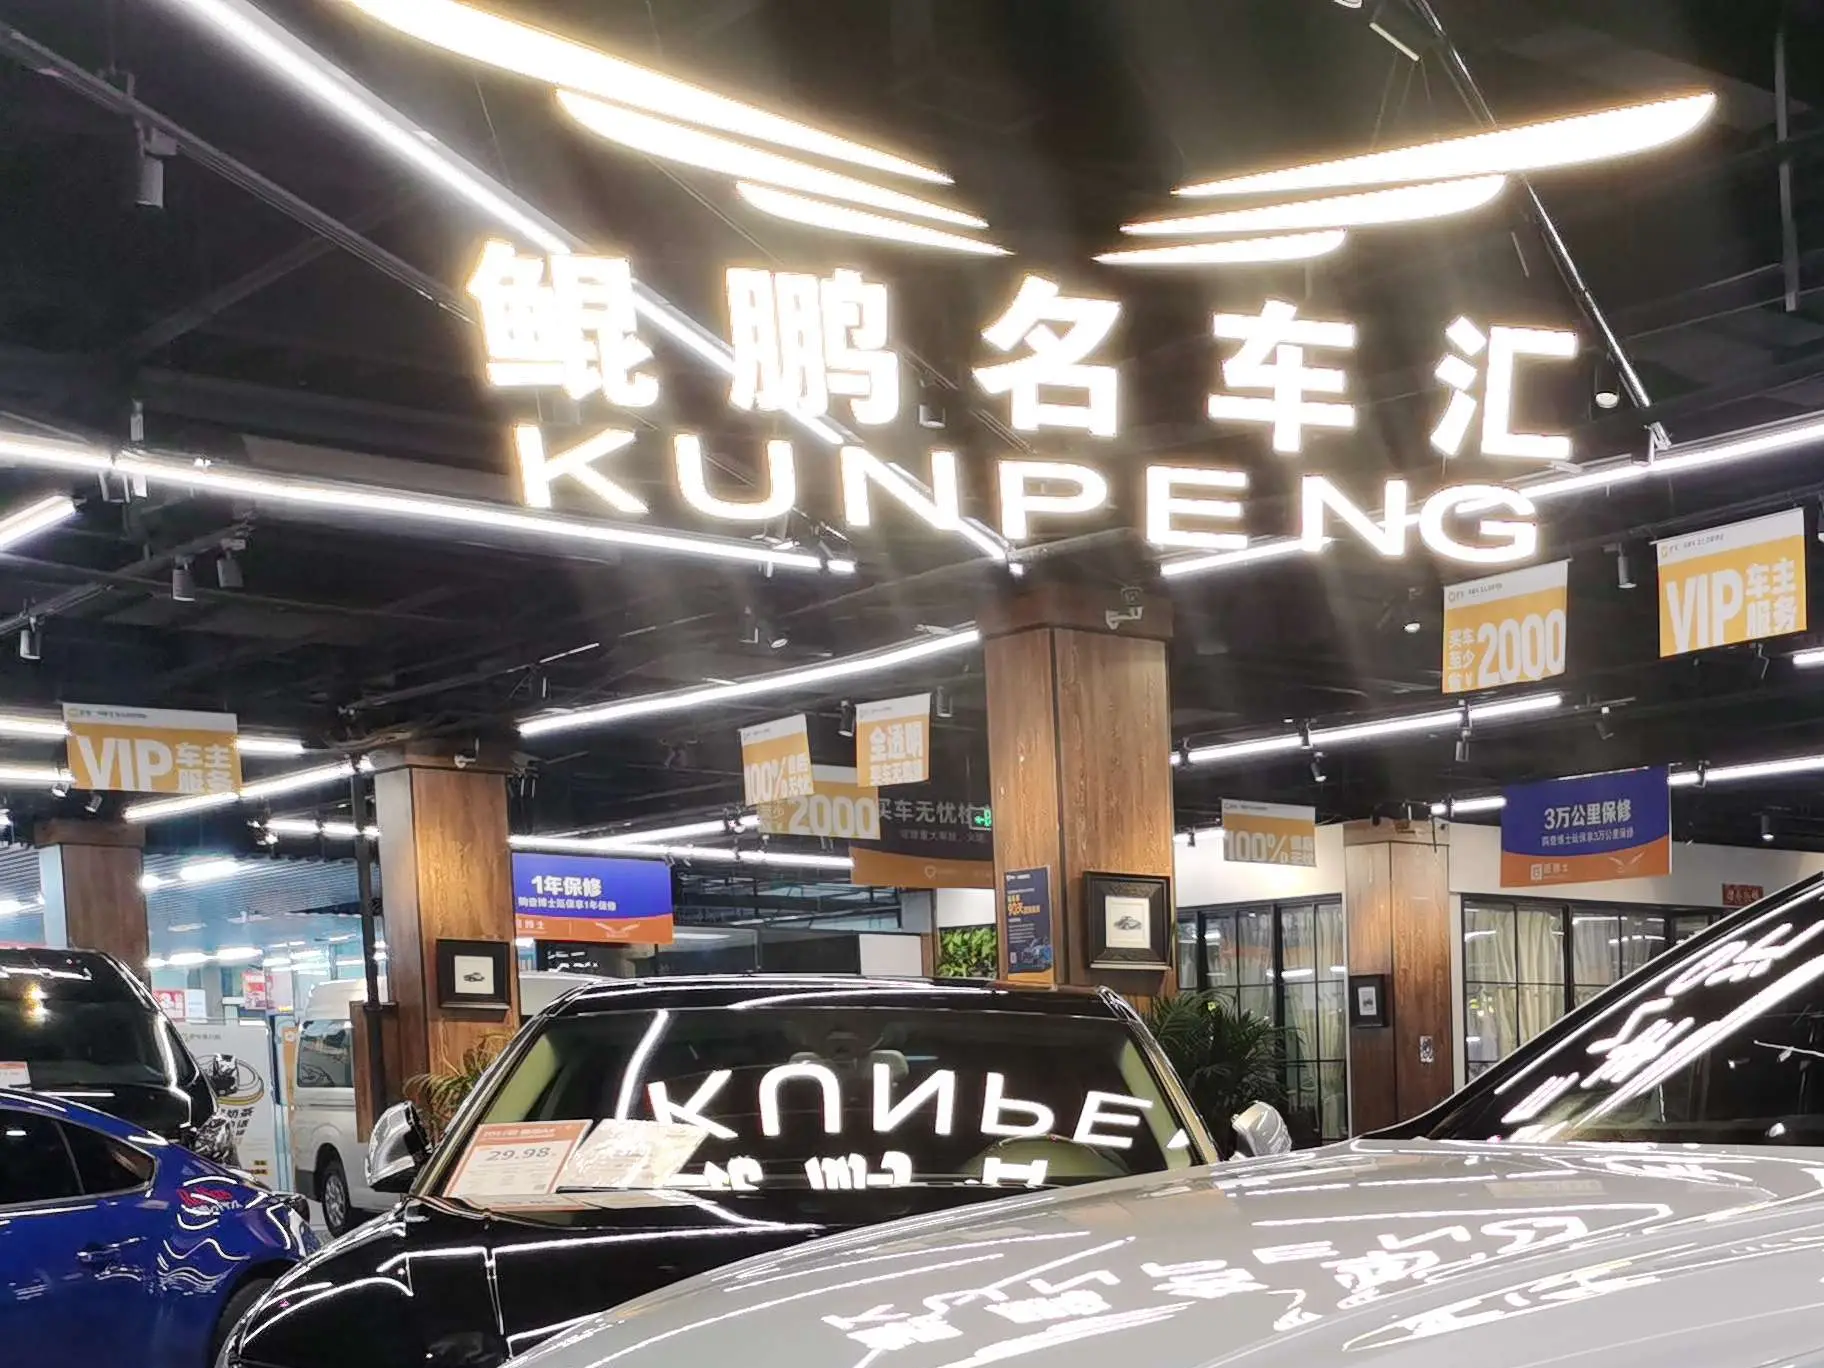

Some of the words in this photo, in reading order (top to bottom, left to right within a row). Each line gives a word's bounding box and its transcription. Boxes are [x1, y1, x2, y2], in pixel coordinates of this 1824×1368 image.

[466, 238, 1580, 462] 鲲鹏名车汇
[512, 420, 1540, 564] KUNPENG
[1666, 569, 1743, 654] VIP
[1477, 608, 1566, 689] 2000
[76, 735, 173, 791] VIP
[744, 756, 788, 805] 100%
[789, 795, 878, 837] 2000
[1544, 799, 1631, 830] 3万公里保修
[1224, 830, 1288, 864] 100%
[531, 875, 602, 897] 1年保修
